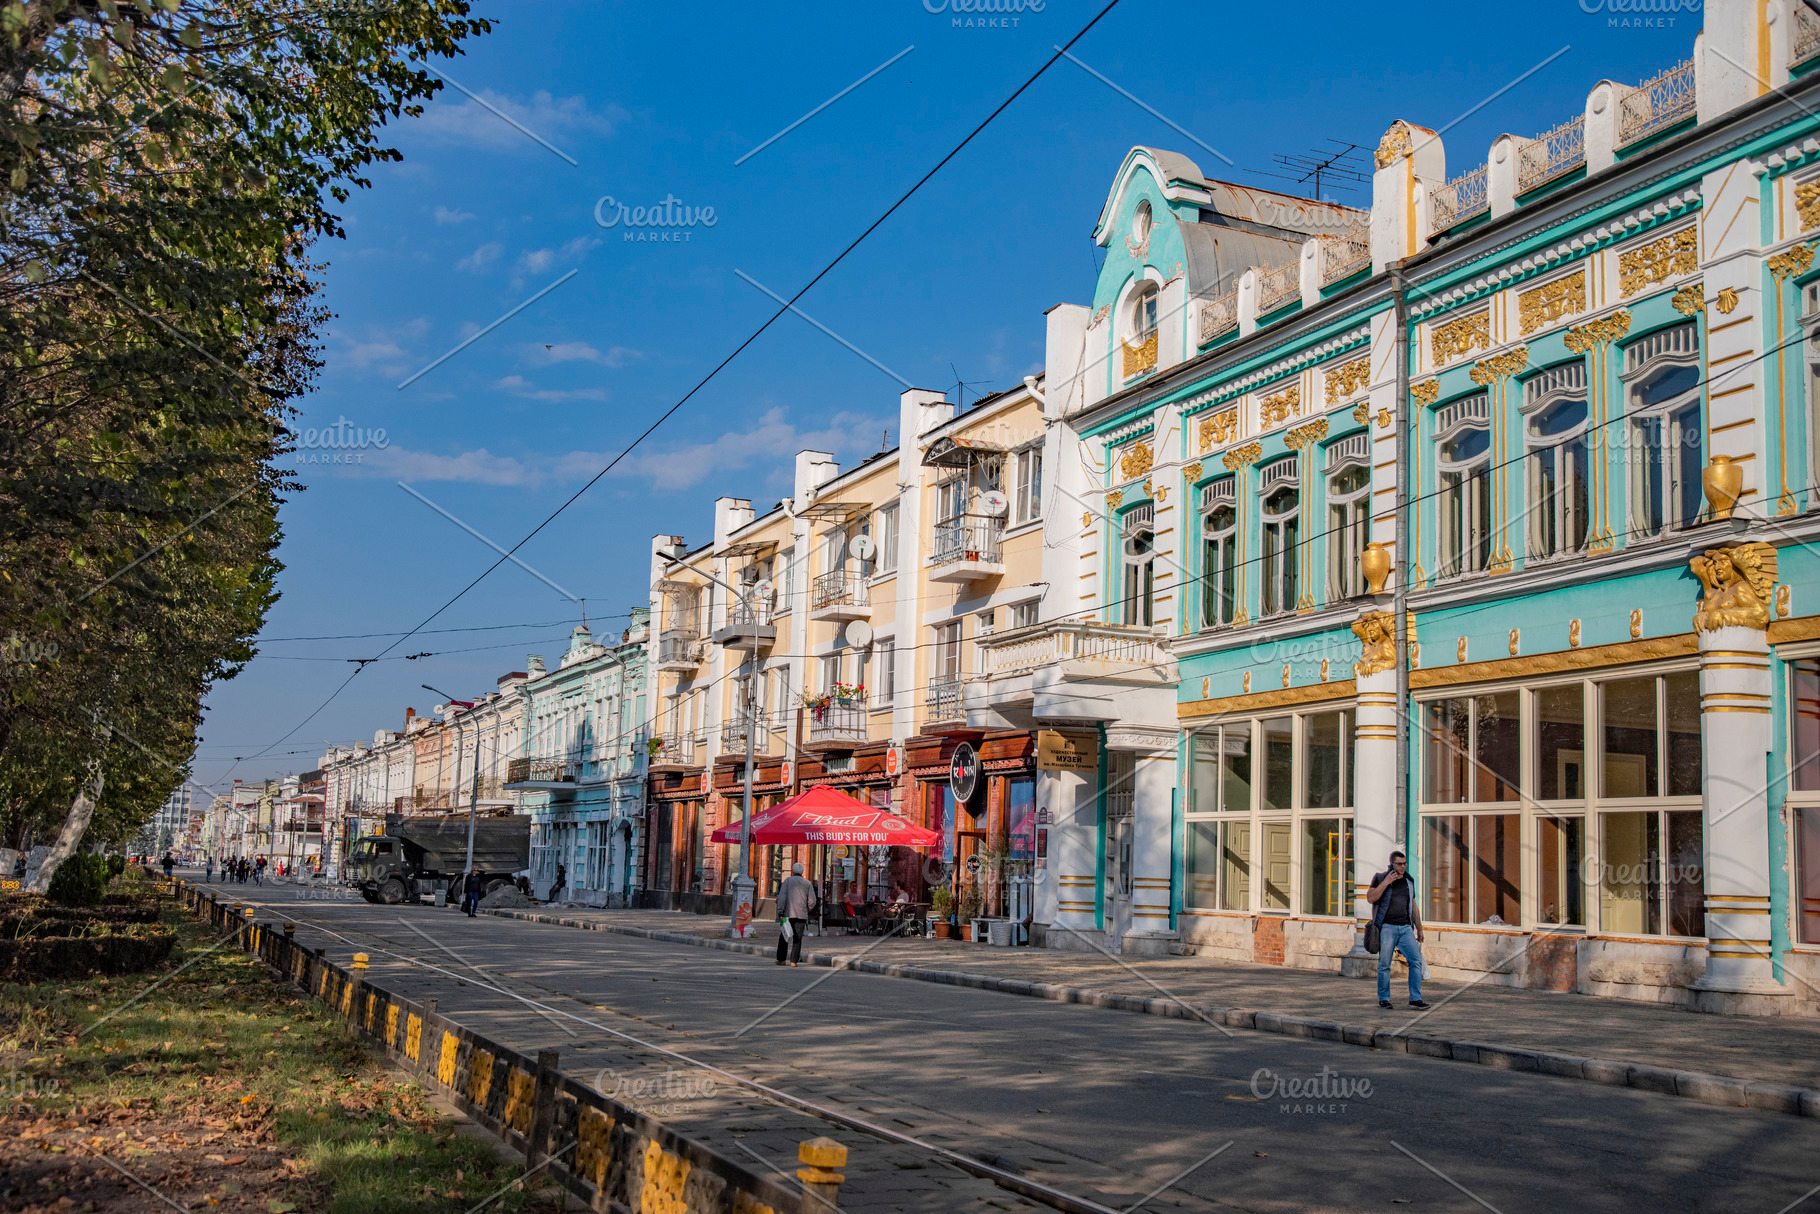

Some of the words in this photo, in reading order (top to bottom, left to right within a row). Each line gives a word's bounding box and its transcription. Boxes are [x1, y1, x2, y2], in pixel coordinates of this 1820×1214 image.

[1056, 755, 1082, 763] МУЗЕЙ
[806, 815, 859, 825] Bud
[805, 832, 824, 841] THIS
[826, 832, 850, 841] BUD'S
[853, 832, 868, 841] FOR
[870, 832, 887, 842] YOU
